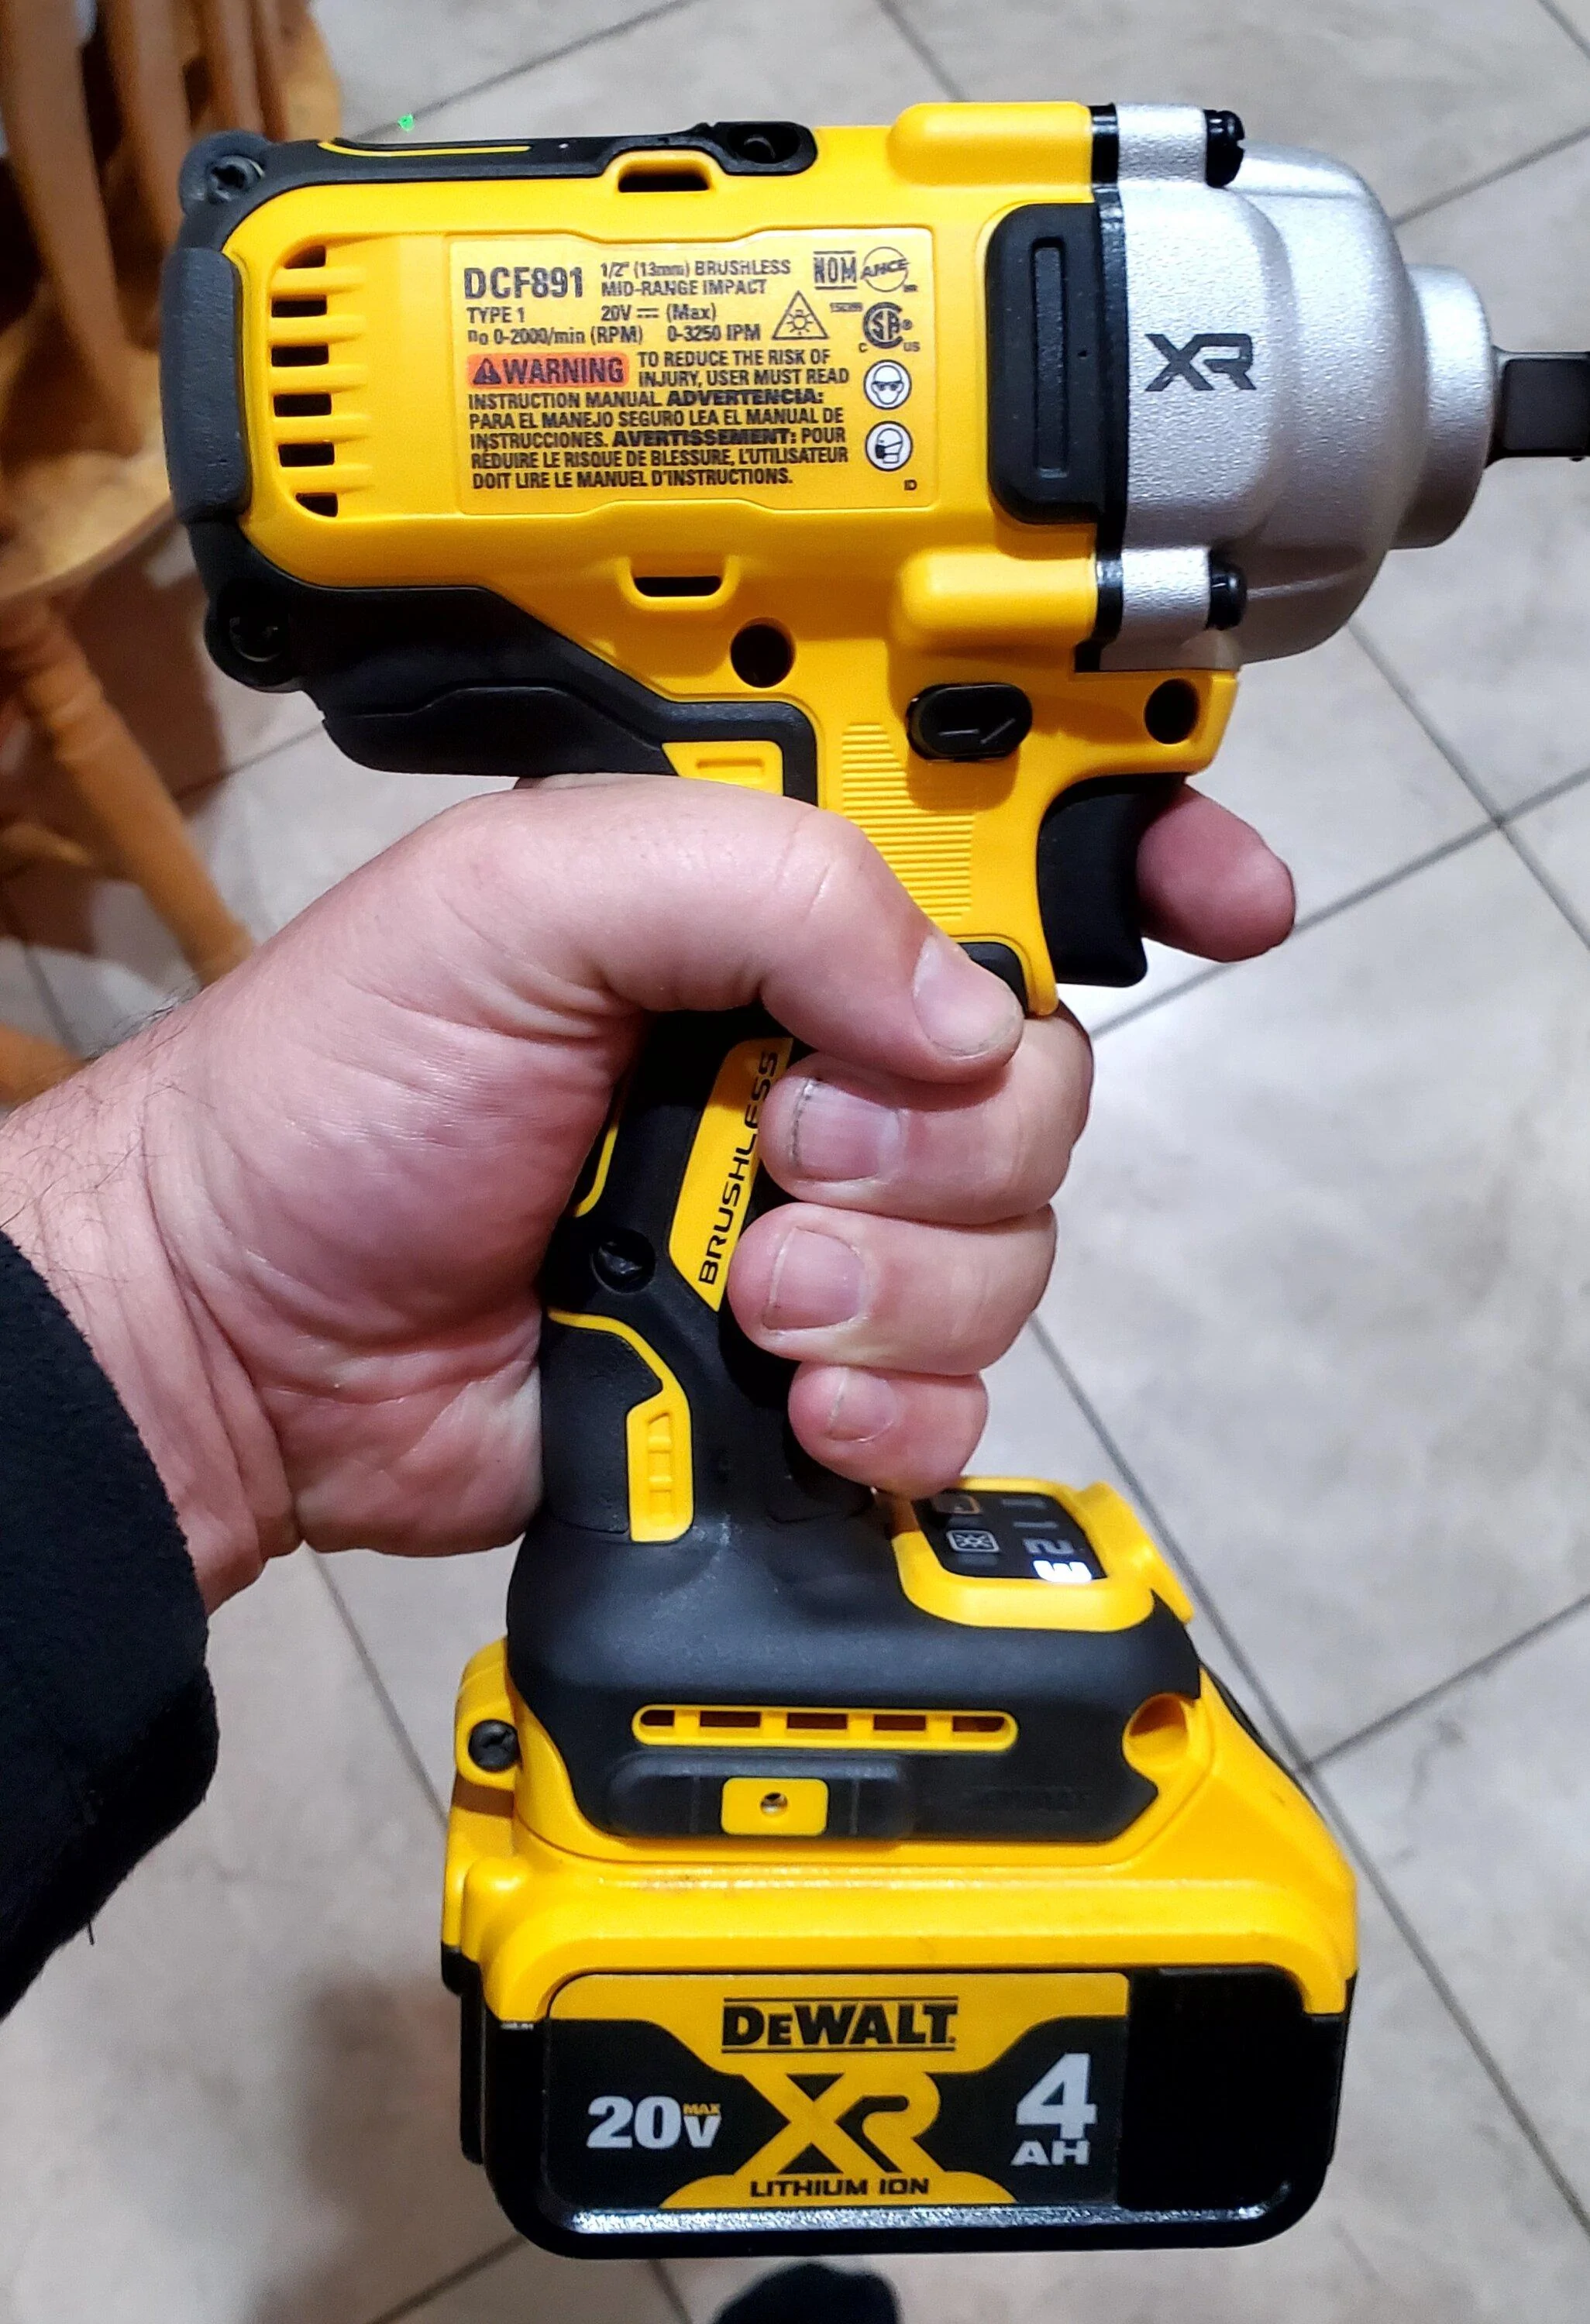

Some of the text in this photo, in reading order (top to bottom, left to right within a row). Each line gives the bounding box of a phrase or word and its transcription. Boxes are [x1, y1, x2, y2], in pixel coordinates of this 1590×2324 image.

[634, 260, 690, 279] (13mm)
[695, 260, 791, 276] BRUSHLESS
[464, 266, 583, 299] DCF891
[601, 278, 767, 297] MID-RANGE IMPACT
[466, 306, 525, 323] TYPE 1
[601, 302, 717, 322] 20V (Max)
[494, 326, 586, 346] 0-2000/min
[590, 325, 643, 346] (RPM)
[667, 324, 721, 342] 0-3250
[727, 323, 761, 341] IPM
[637, 348, 831, 368] TO REDUCE THE RISK OF
[1144, 333, 1257, 391] XR
[504, 356, 624, 384] WARNING
[638, 367, 849, 389] INJURY, USER MUST READ
[468, 392, 580, 410] INSTRUCTION
[666, 388, 824, 407] ADVERTENCIA:
[470, 407, 845, 429] PARA EL MANEJO SEGURO LEA EL MANUAL DE
[470, 427, 845, 449] INSTRUCCIONES. AVERTISSEMENT: POUR
[543, 451, 561, 468] LE
[564, 450, 621, 468] RISQUE
[626, 449, 646, 466] DE
[650, 448, 735, 466] BLESSURE,
[738, 446, 848, 465] L'UTILISATEUR
[473, 467, 793, 490] DOIT LIRE LE MANUEL D'INSTRUCTIONS.
[698, 1050, 778, 1285] BRUSHLESS
[1015, 2052, 1098, 2140] 4
[683, 2103, 722, 2116] MAX
[735, 2071, 945, 2174] XR
[1010, 2140, 1090, 2166] AH
[750, 2178, 929, 2198] LITHIUM ION
